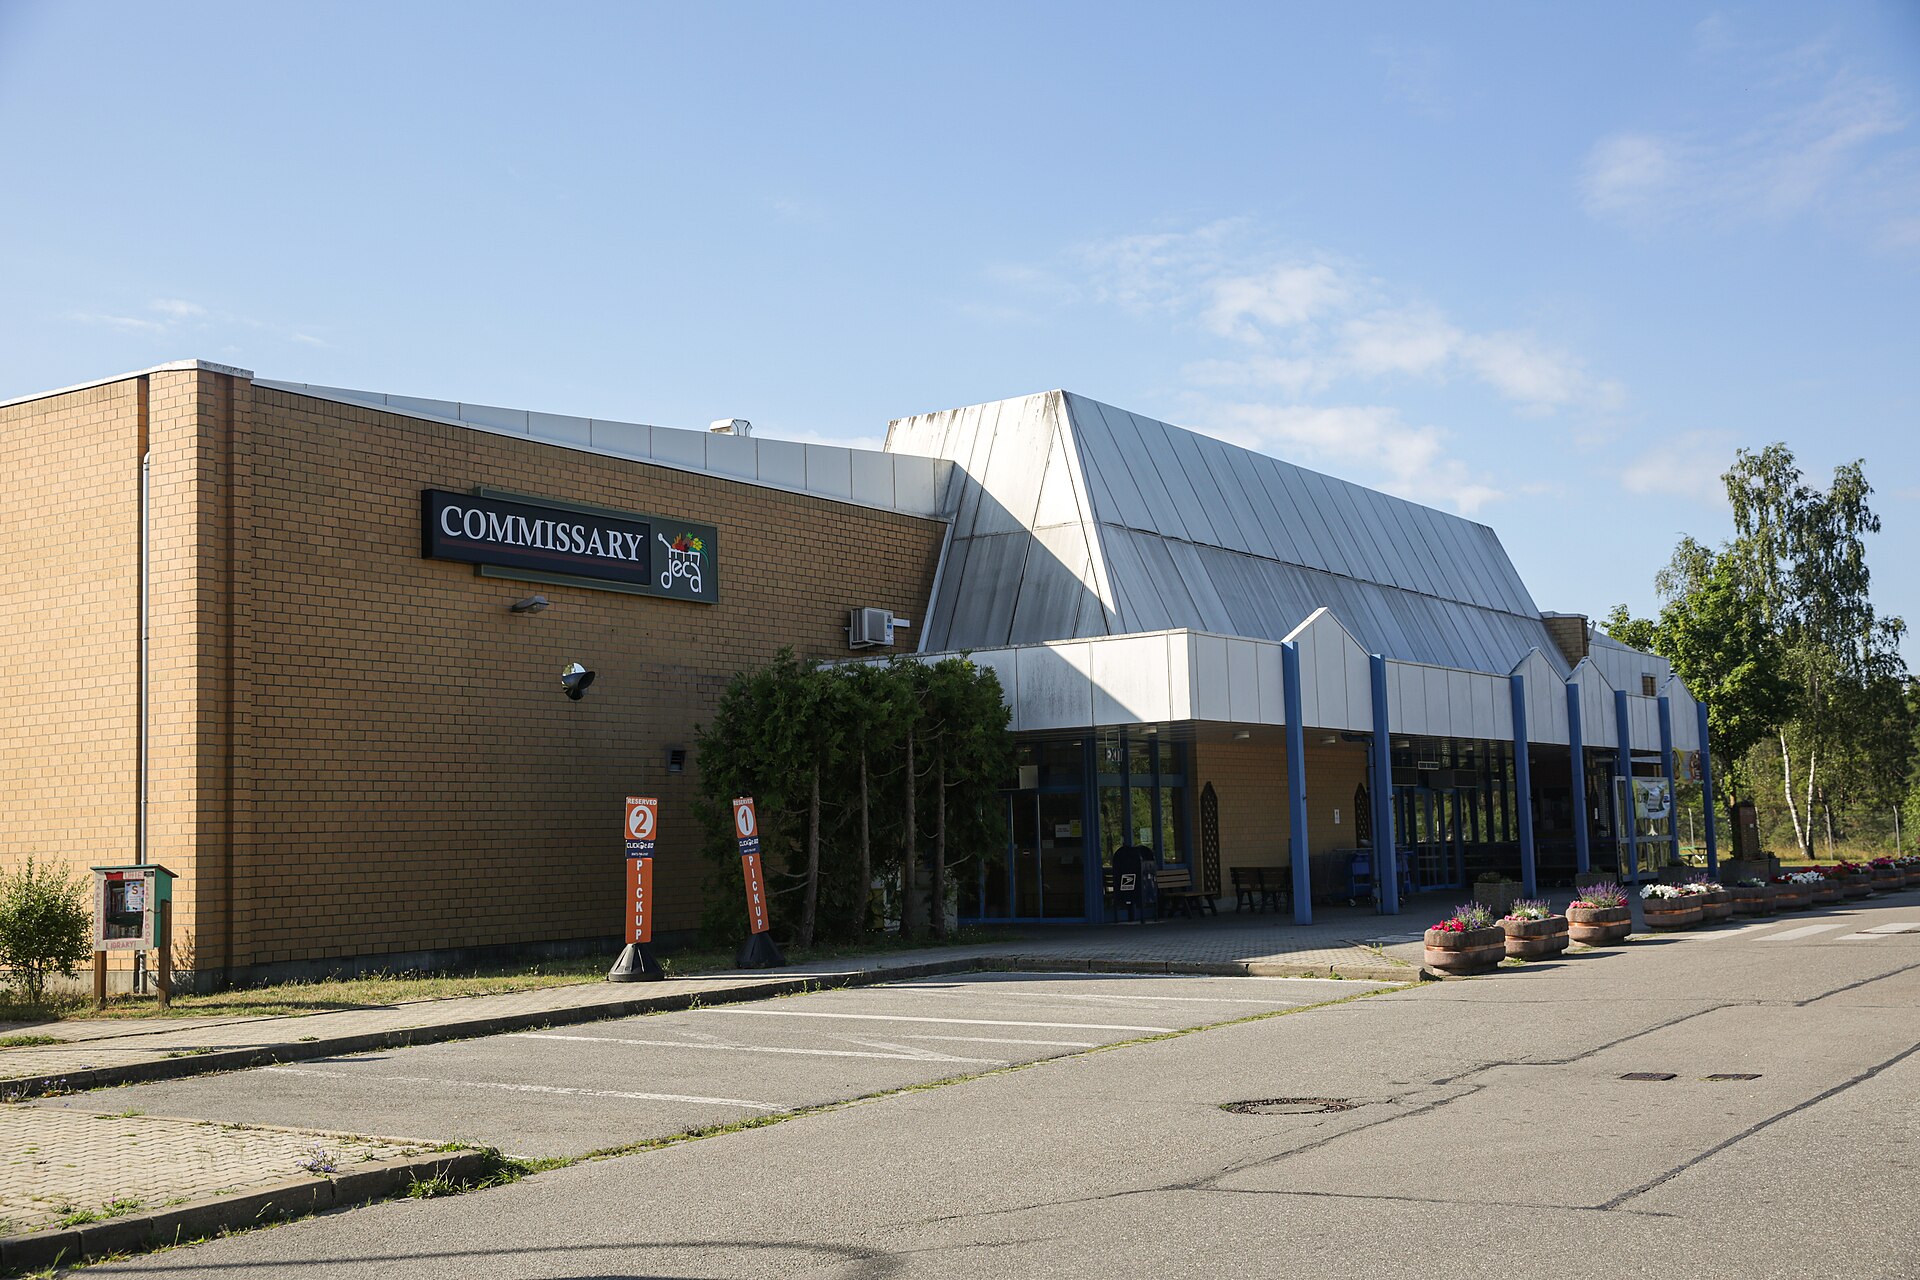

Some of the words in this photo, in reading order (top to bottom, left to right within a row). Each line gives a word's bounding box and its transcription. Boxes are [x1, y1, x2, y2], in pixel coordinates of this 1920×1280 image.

[440, 505, 644, 562] COMMISSARY
[627, 798, 657, 806] RESERVED
[635, 809, 647, 833] 2
[741, 809, 749, 832] 1
[635, 860, 643, 940] PICKUP
[748, 856, 762, 929] PICKUP
